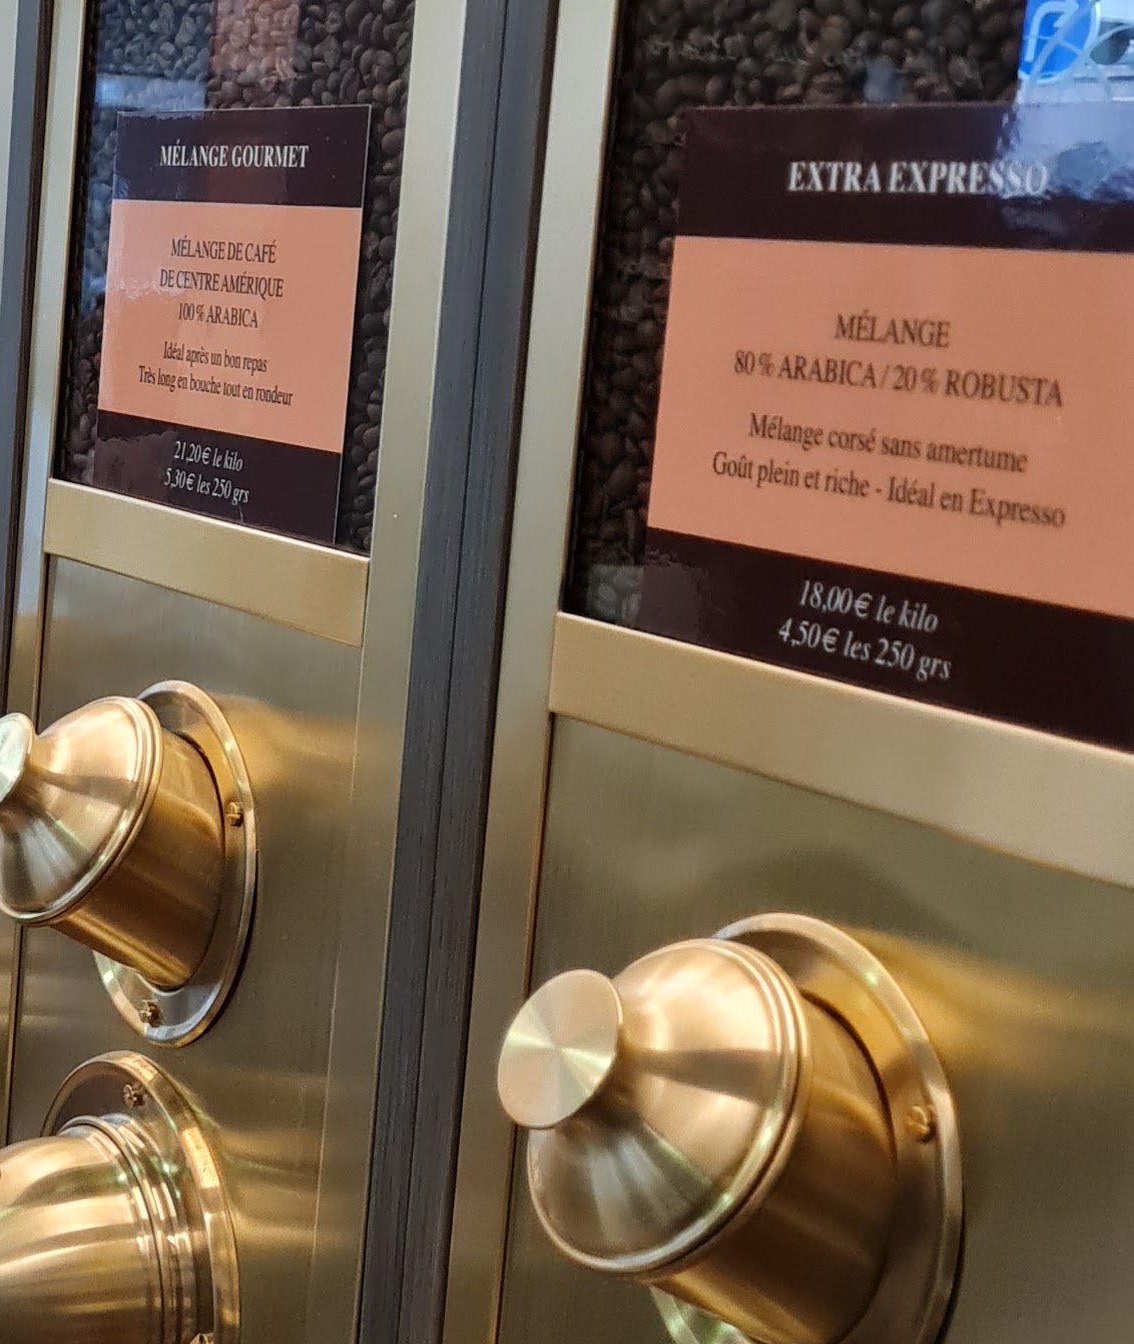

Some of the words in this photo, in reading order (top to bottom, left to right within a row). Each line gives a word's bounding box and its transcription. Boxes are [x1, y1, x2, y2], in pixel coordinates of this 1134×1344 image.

[160, 139, 229, 167] MÉLANGE
[231, 145, 309, 168] GOURMET
[788, 160, 880, 193] EXTRA
[888, 160, 1049, 197] EXPRESSO
[170, 235, 225, 260] MÉLANGE
[227, 241, 243, 261] DE
[245, 239, 277, 264] CAFÉ
[159, 268, 175, 288] DE
[176, 270, 220, 292] CENTRE
[220, 270, 284, 301] AMÉRIQUE
[206, 305, 258, 329] ARABICA
[834, 309, 950, 349] MÉLANGE
[163, 340, 185, 361] Idéal
[186, 346, 209, 367] après
[211, 354, 222, 367] un
[224, 349, 241, 370] bon
[242, 356, 268, 376] repas
[138, 365, 156, 385] Très
[157, 368, 176, 392] long
[177, 375, 188, 390] en
[189, 373, 222, 395] bouche
[223, 381, 241, 398] tout
[242, 385, 253, 400] en
[255, 385, 293, 406] rondeur
[778, 354, 877, 390] ARABICA
[943, 369, 1064, 408] ROBUSTA
[174, 440, 212, 464] 21,20€
[212, 448, 223, 467] le
[223, 450, 243, 472] kilo
[749, 412, 824, 449] Mélange
[828, 425, 877, 453] corsé
[881, 437, 921, 460] sans
[926, 442, 1028, 474] amertume
[164, 467, 196, 491] 5,30€
[196, 474, 211, 495] les
[211, 477, 232, 499] 250
[231, 487, 250, 506] grs
[713, 451, 754, 481] Goût
[757, 461, 800, 488] plein
[804, 470, 820, 490] et
[824, 468, 870, 498] riche
[887, 476, 937, 508] Idéal
[940, 491, 964, 512] en
[967, 488, 1066, 529] Expresso
[799, 578, 872, 619] 18,00€
[876, 595, 896, 621] le
[898, 600, 939, 633] kilo
[778, 617, 840, 654] 4,50€
[843, 629, 872, 660] les
[874, 638, 916, 672] 250
[916, 653, 952, 683] grs
